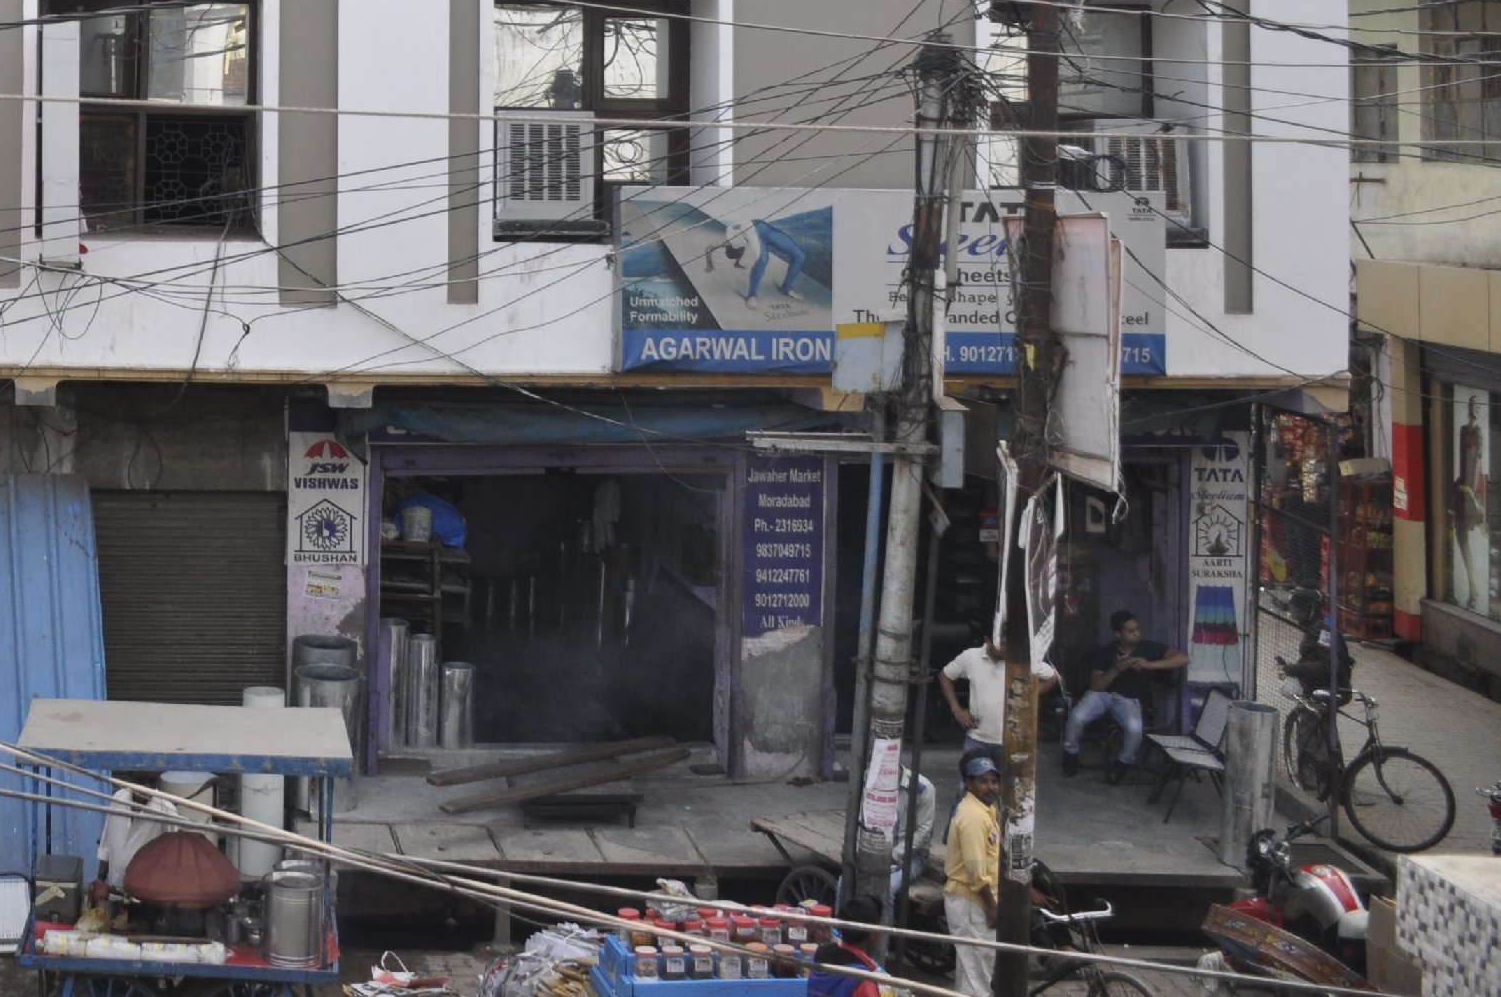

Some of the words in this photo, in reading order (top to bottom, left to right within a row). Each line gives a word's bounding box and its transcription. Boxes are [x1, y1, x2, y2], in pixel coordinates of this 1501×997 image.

[629, 296, 698, 308] Unmatched
[629, 310, 698, 324] Formability
[640, 336, 765, 361] AGARWAL
[771, 337, 831, 362] IRON
[304, 462, 349, 476] JSW
[747, 467, 788, 483] Jawaher
[789, 467, 821, 483] Market
[1194, 467, 1244, 483] TATA
[294, 477, 359, 490] VISHWAS
[758, 492, 811, 508] Moradabad
[293, 554, 358, 563] BHUSHAN
[1203, 558, 1233, 567] AARTI
[755, 568, 810, 583] 9412247761
[1191, 570, 1243, 579] SURAKSHA
[755, 593, 810, 608] 9012712000
[760, 614, 775, 628] All
